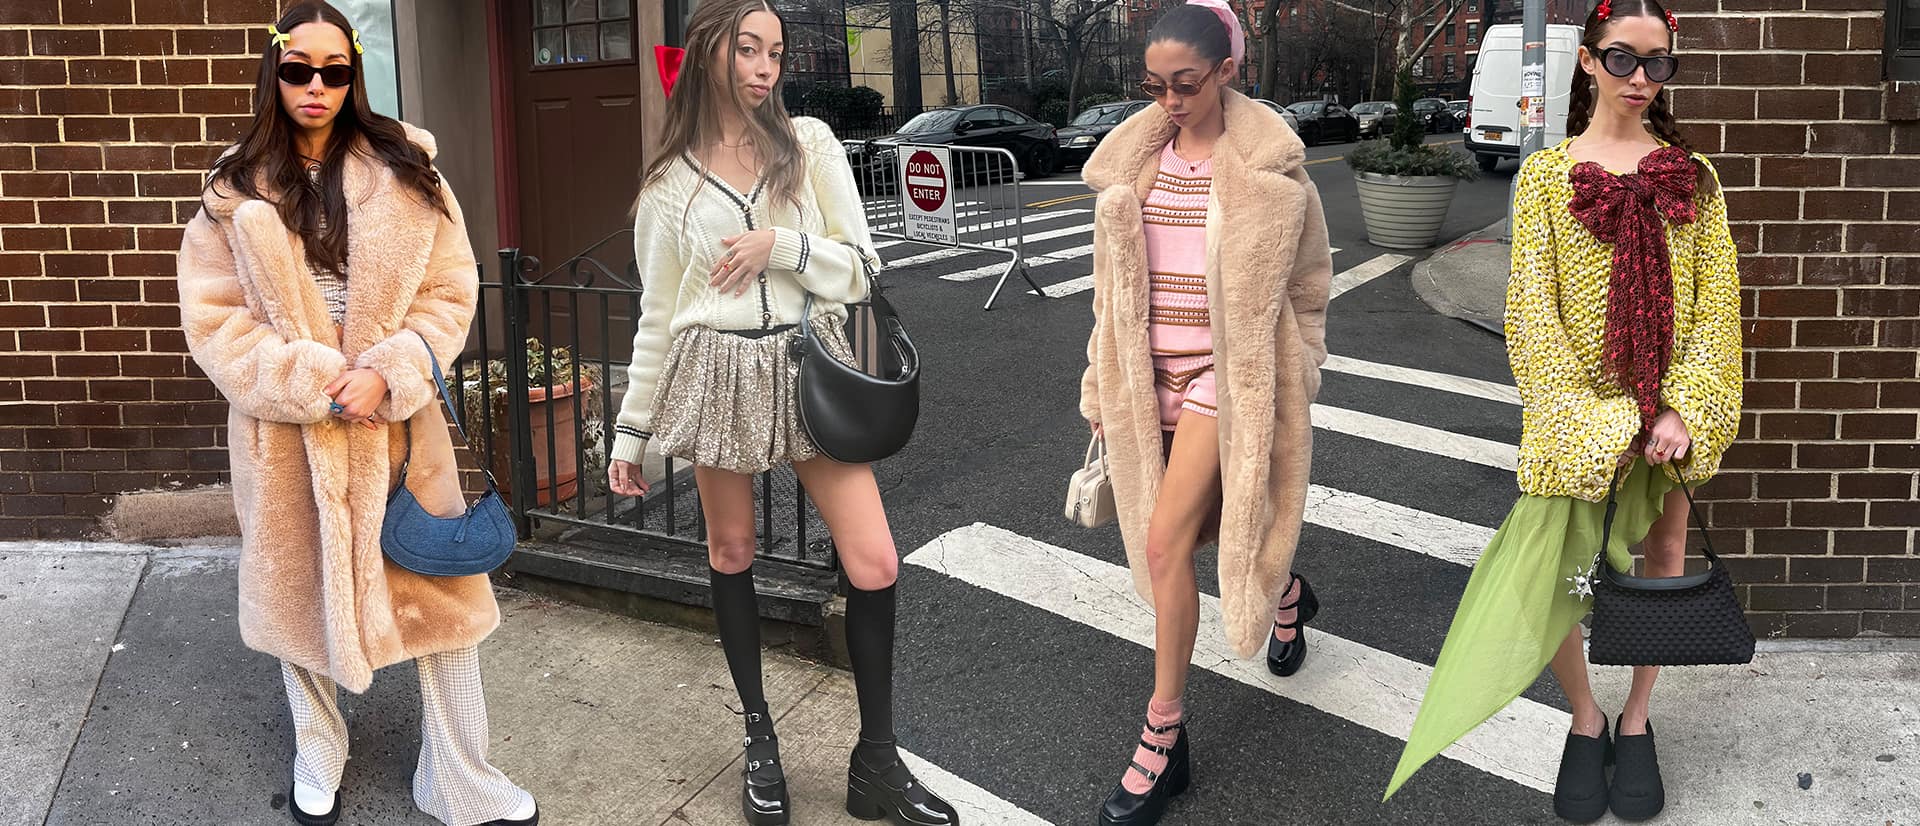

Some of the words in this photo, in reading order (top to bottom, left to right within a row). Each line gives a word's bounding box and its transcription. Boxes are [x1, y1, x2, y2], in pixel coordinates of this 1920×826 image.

[909, 162, 921, 173] DO
[923, 163, 940, 175] NOT
[913, 188, 941, 200] ENTER
[924, 216, 950, 224] PEDESTRIANS
[917, 223, 938, 231] BICYCLISTS
[914, 231, 926, 239] LOCAL
